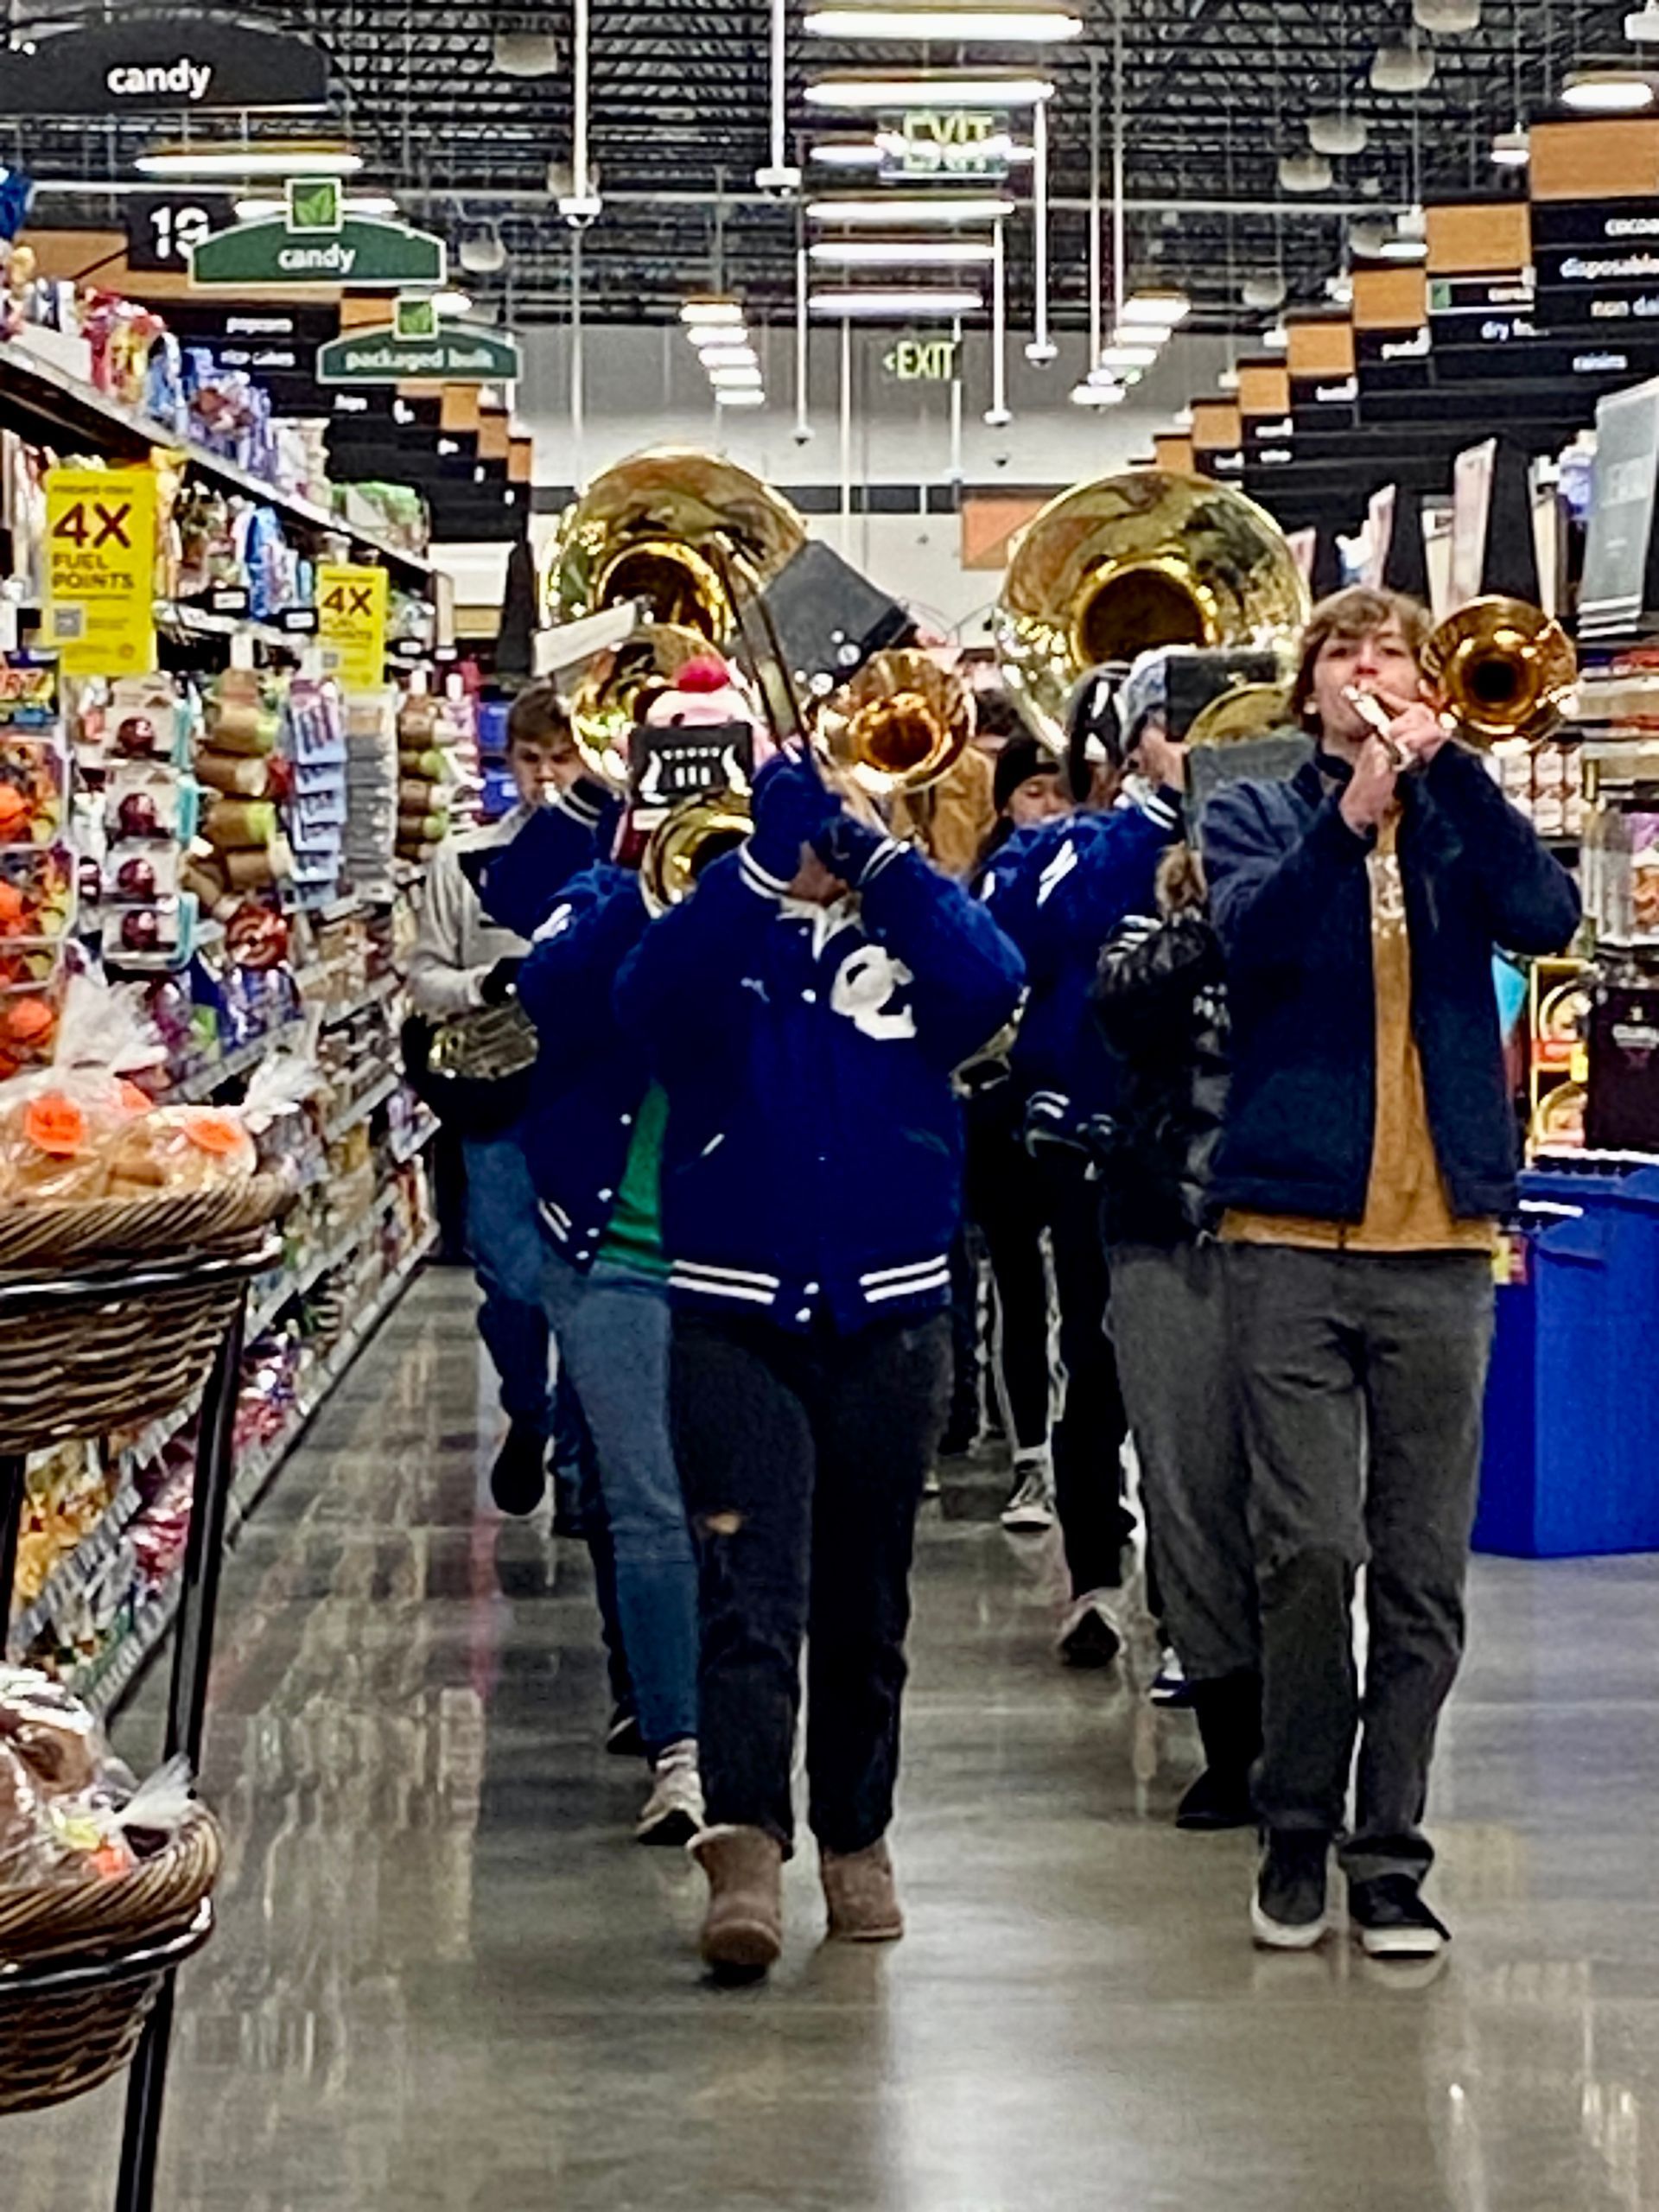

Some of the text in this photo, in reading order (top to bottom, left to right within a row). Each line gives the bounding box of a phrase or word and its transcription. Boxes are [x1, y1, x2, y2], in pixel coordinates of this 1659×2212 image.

[107, 58, 212, 99] candy
[278, 244, 356, 272] candy
[897, 340, 956, 380] EXIT
[53, 502, 132, 549] 4X
[53, 553, 109, 570] FUEL
[53, 572, 135, 589] POINTS
[322, 585, 373, 617] 4X
